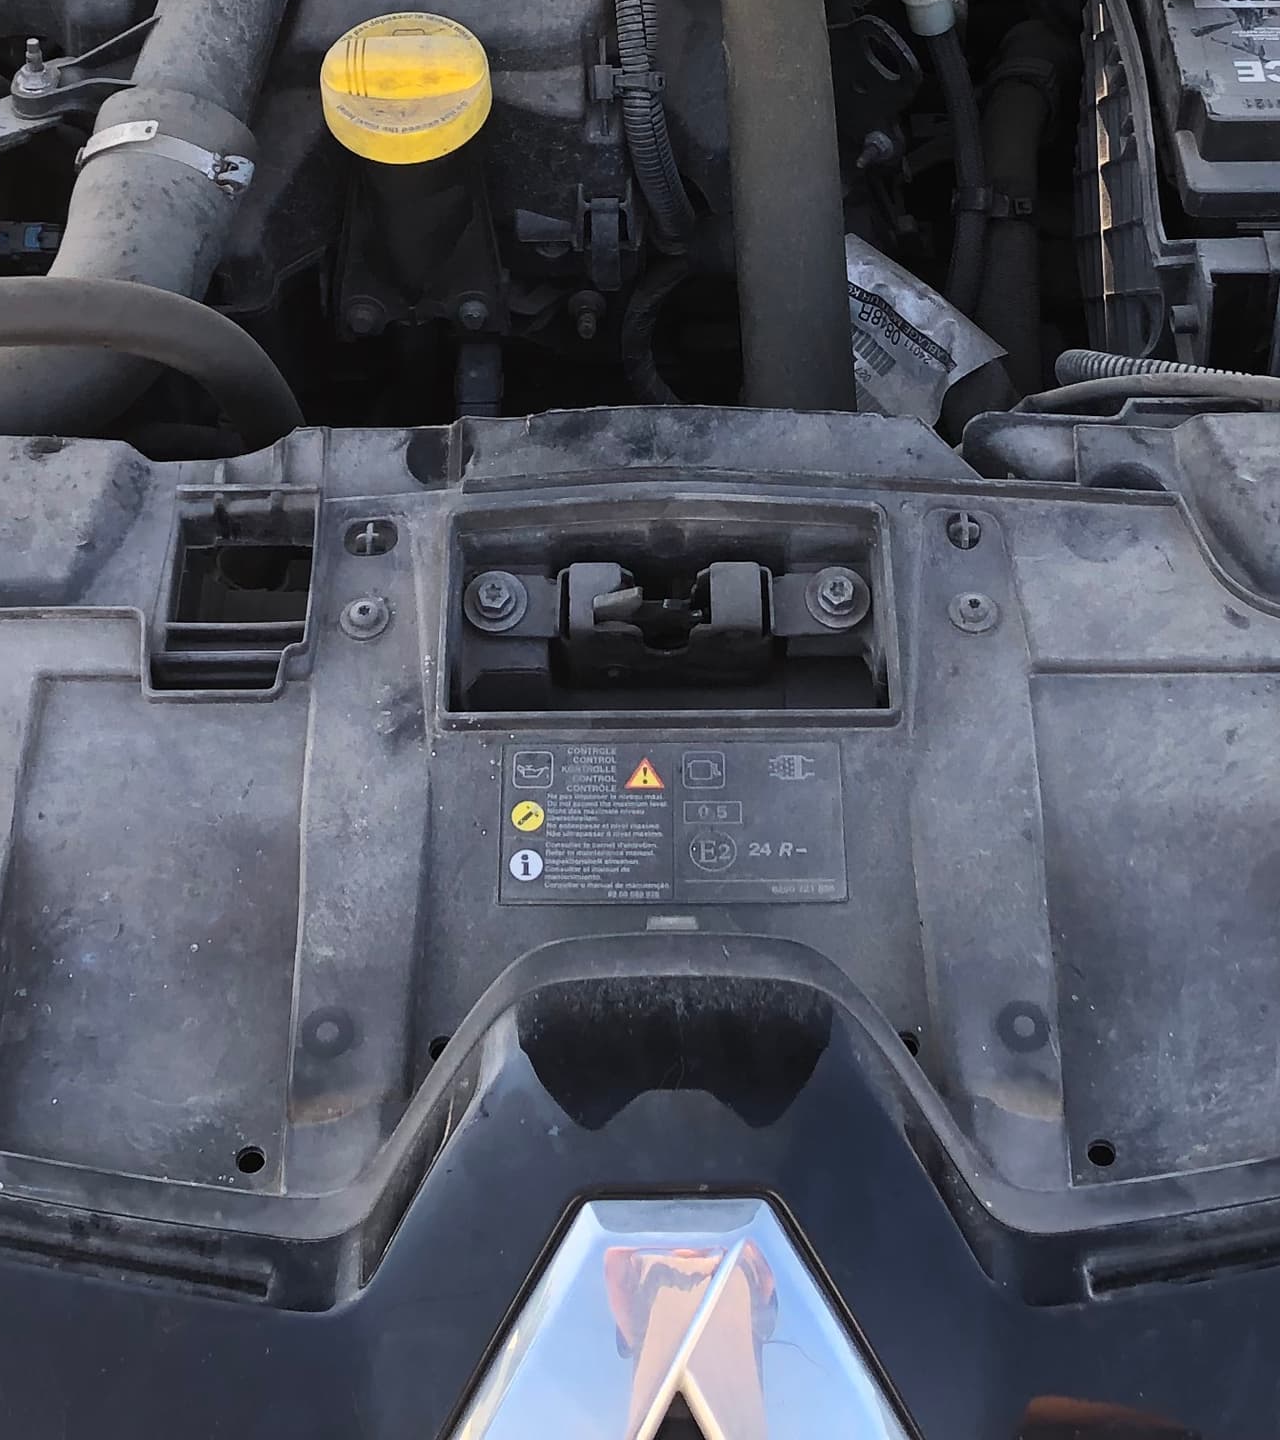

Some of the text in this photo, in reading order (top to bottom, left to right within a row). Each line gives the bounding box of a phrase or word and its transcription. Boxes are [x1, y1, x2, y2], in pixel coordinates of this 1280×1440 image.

[858, 303, 932, 365] 24011 0848R
[573, 756, 617, 764] CONTROL
[698, 840, 731, 863] E2
[748, 842, 772, 857] 24
